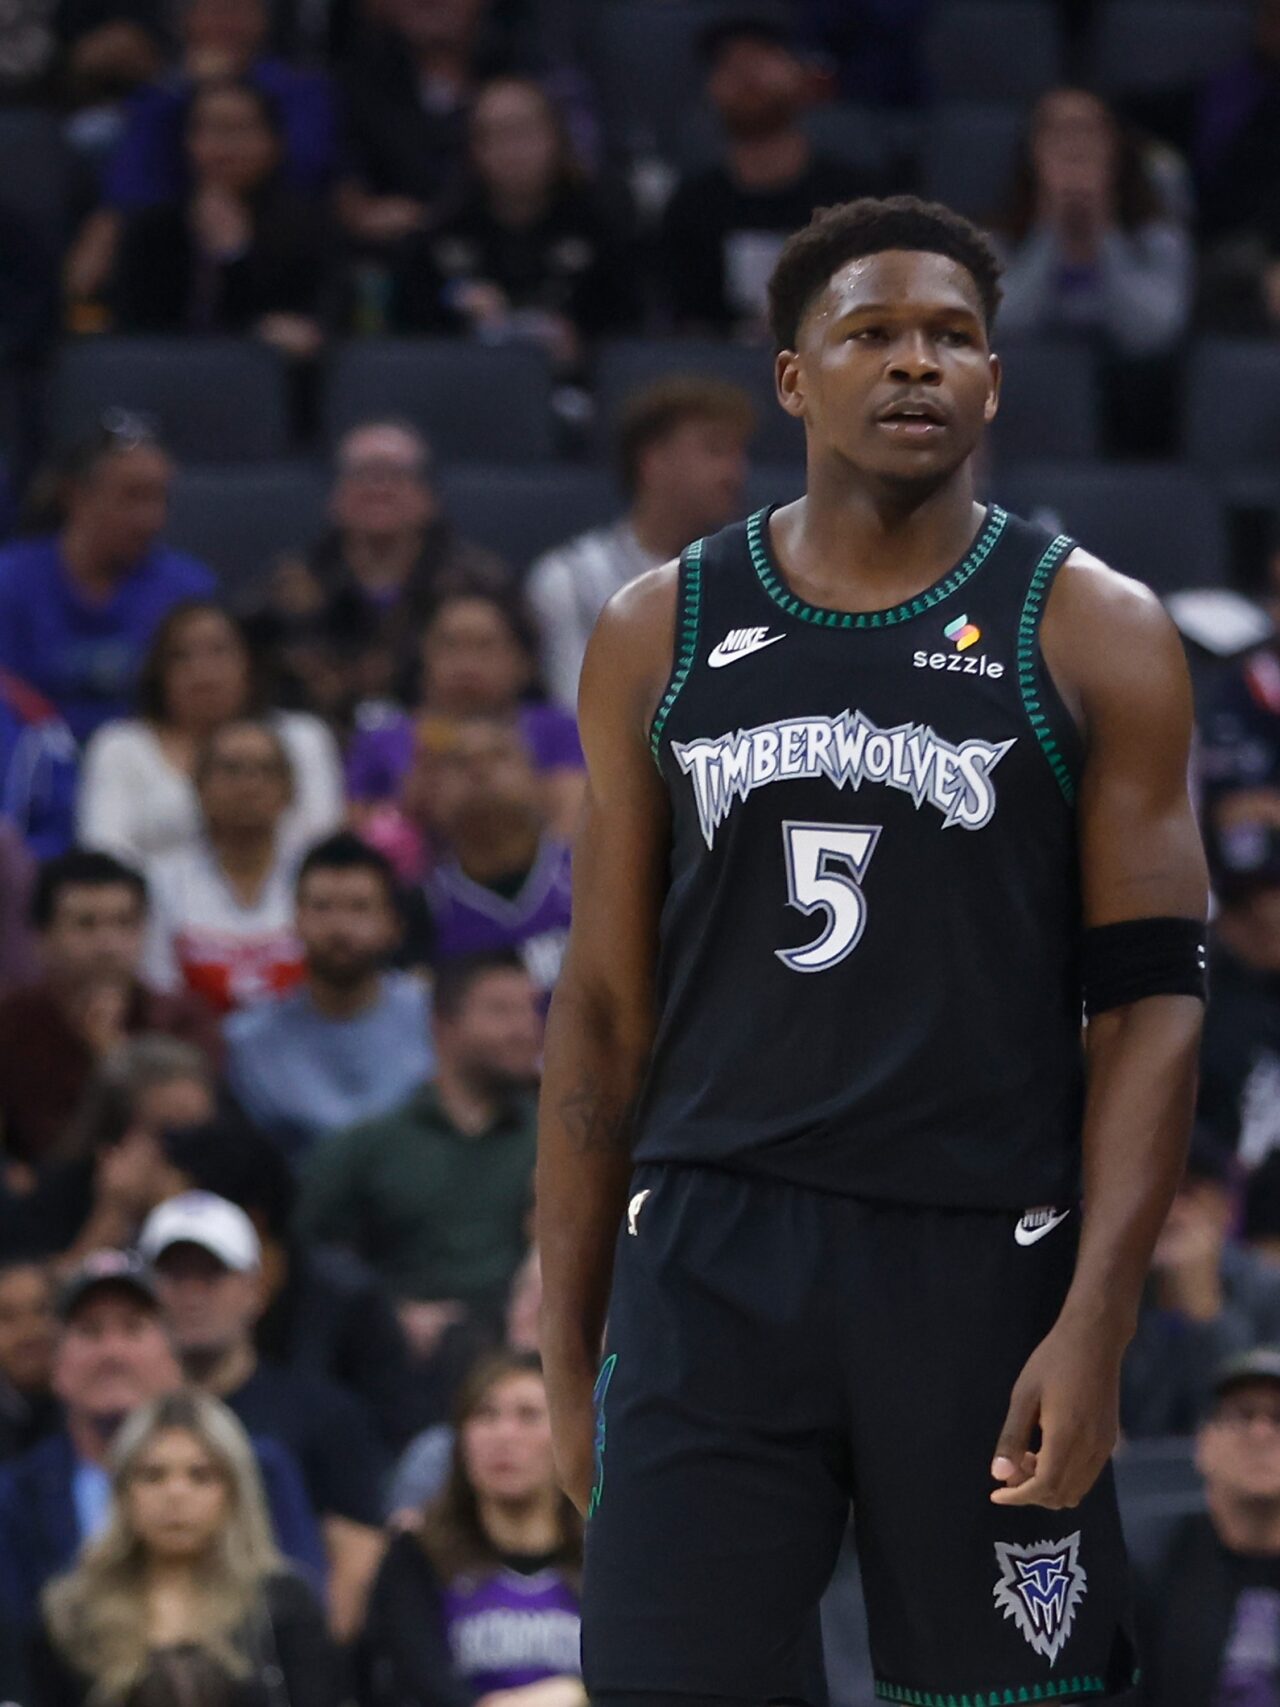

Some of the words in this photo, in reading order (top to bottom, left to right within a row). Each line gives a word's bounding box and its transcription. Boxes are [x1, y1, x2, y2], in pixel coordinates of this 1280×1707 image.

[720, 626, 770, 653] NIKE
[913, 650, 1005, 679] sezzle
[671, 708, 1018, 851] TIMBERWOLVES
[774, 820, 883, 973] 5
